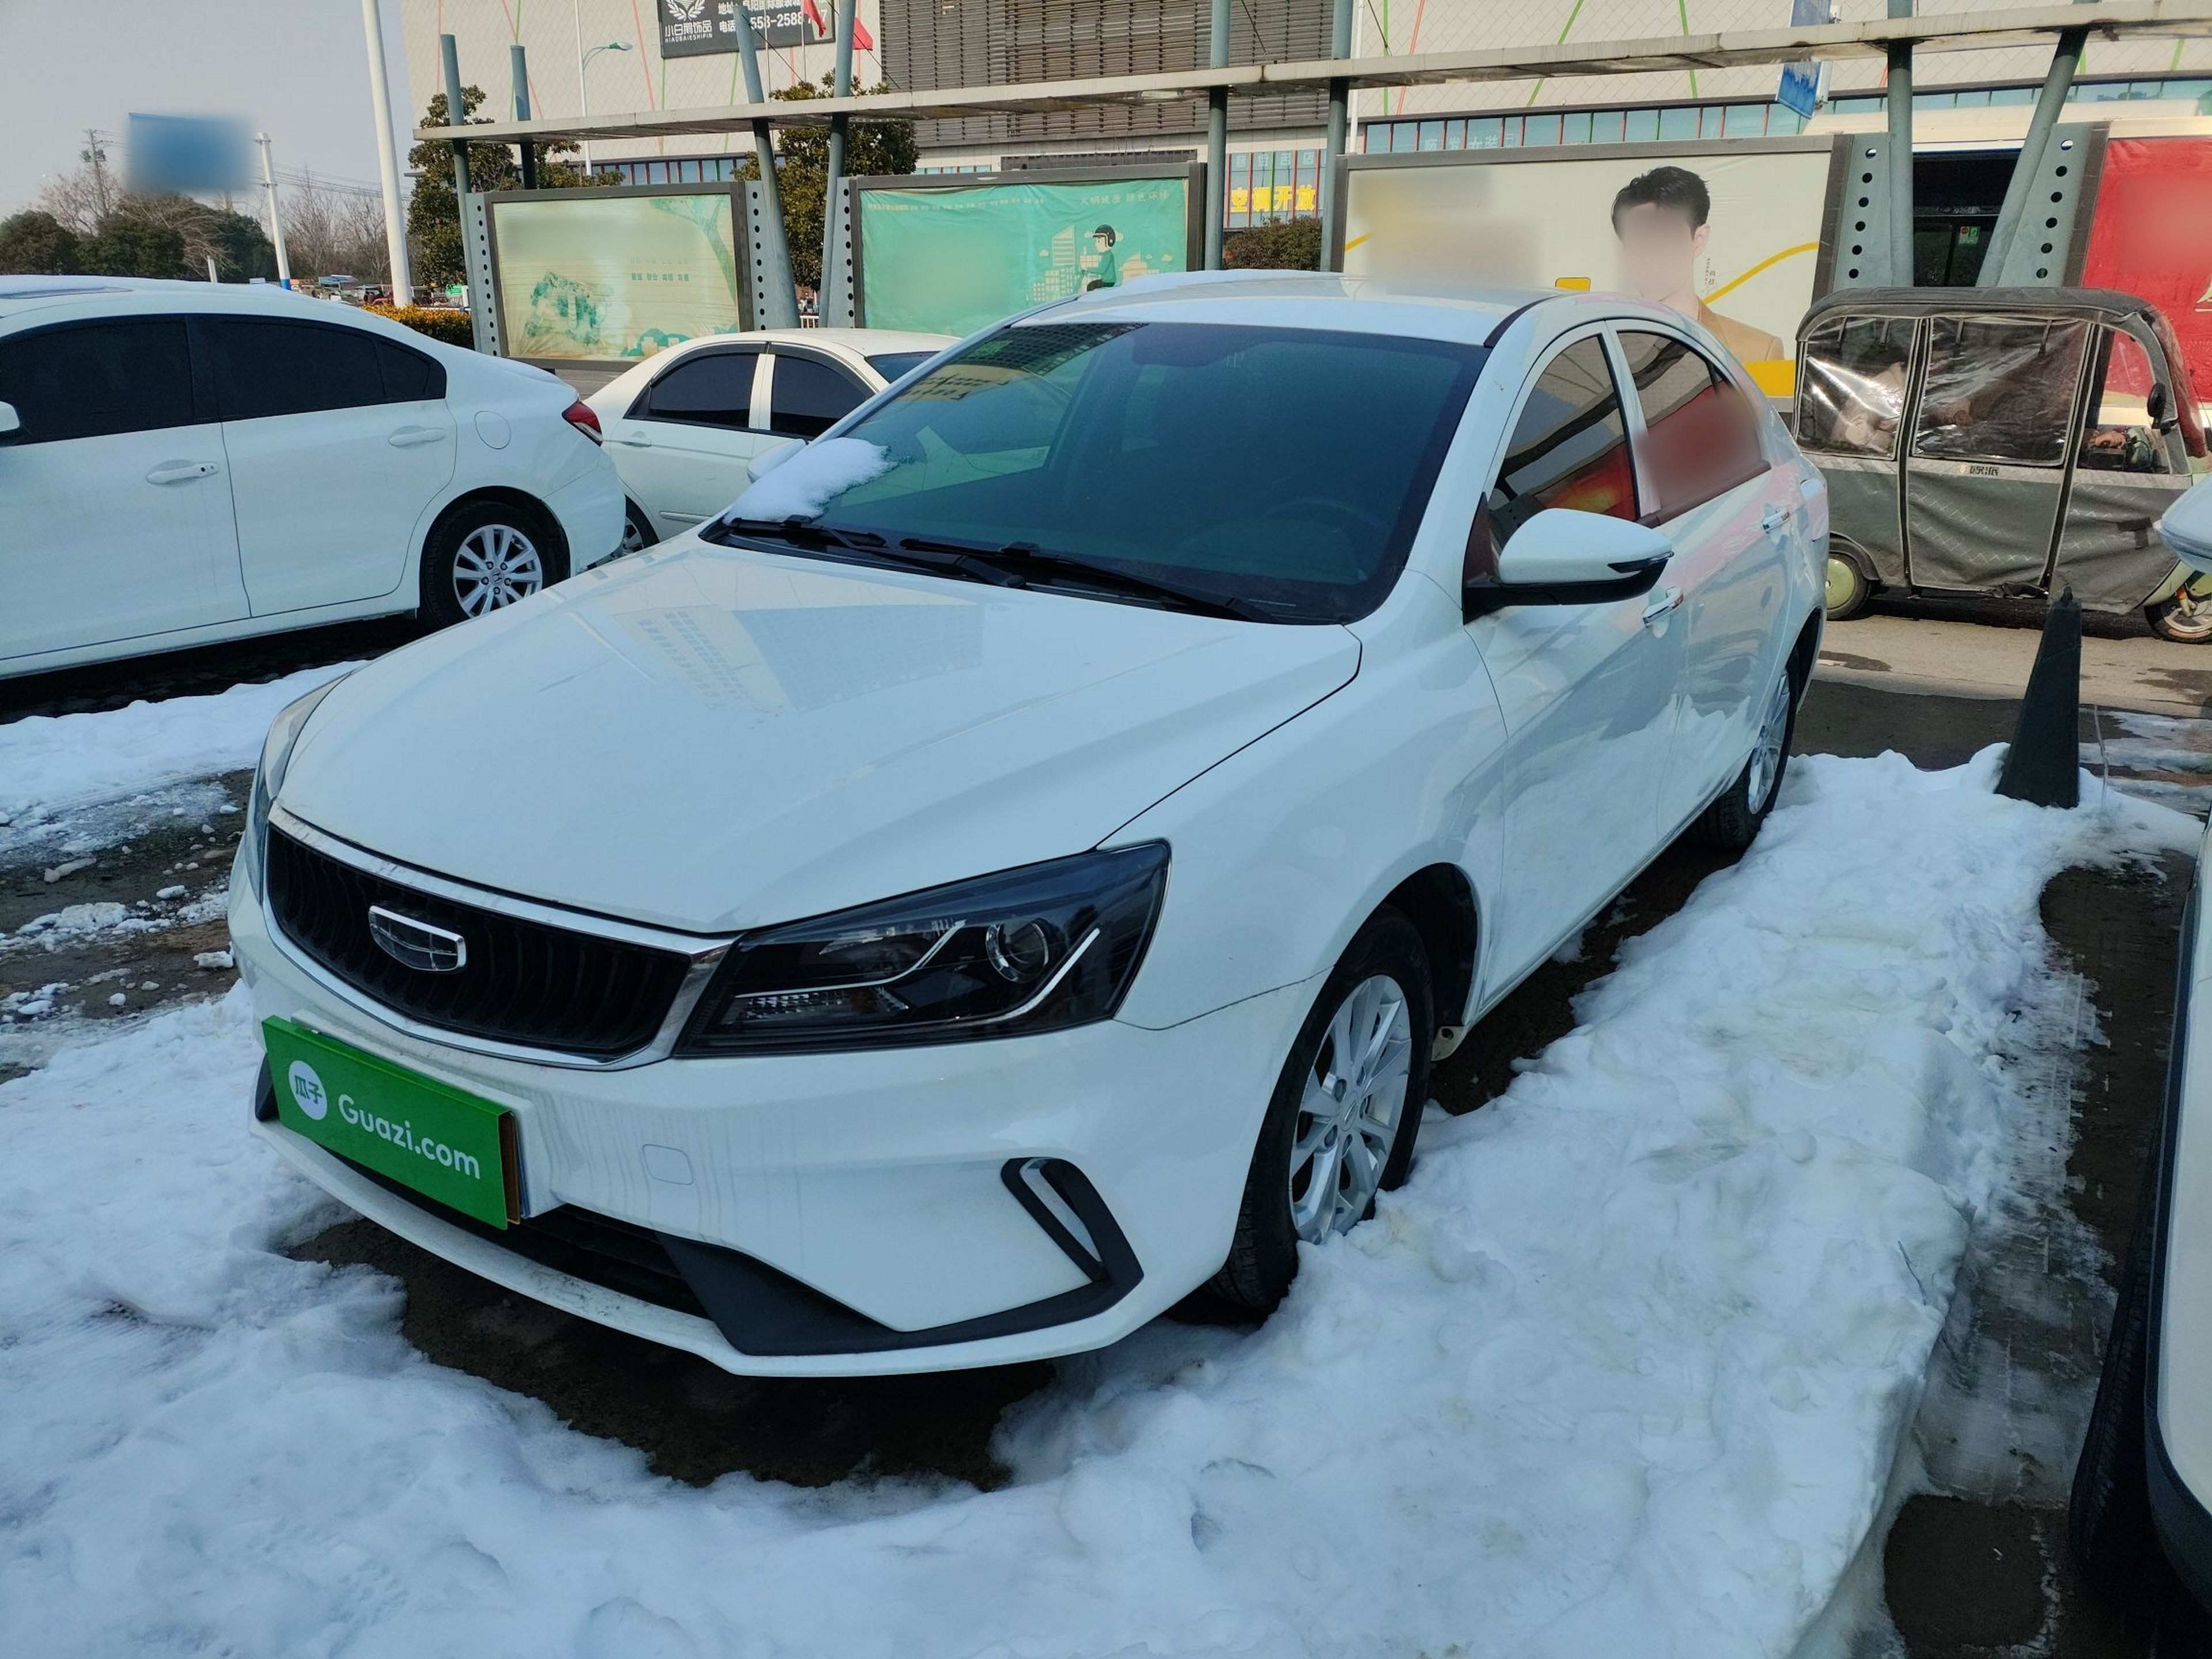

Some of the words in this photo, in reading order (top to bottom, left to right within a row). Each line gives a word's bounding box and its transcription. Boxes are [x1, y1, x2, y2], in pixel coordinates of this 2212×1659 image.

[665, 20, 712, 37] 小白鹅饰品
[294, 1075, 323, 1104] 瓜子
[338, 1093, 480, 1180] Guazi.com
